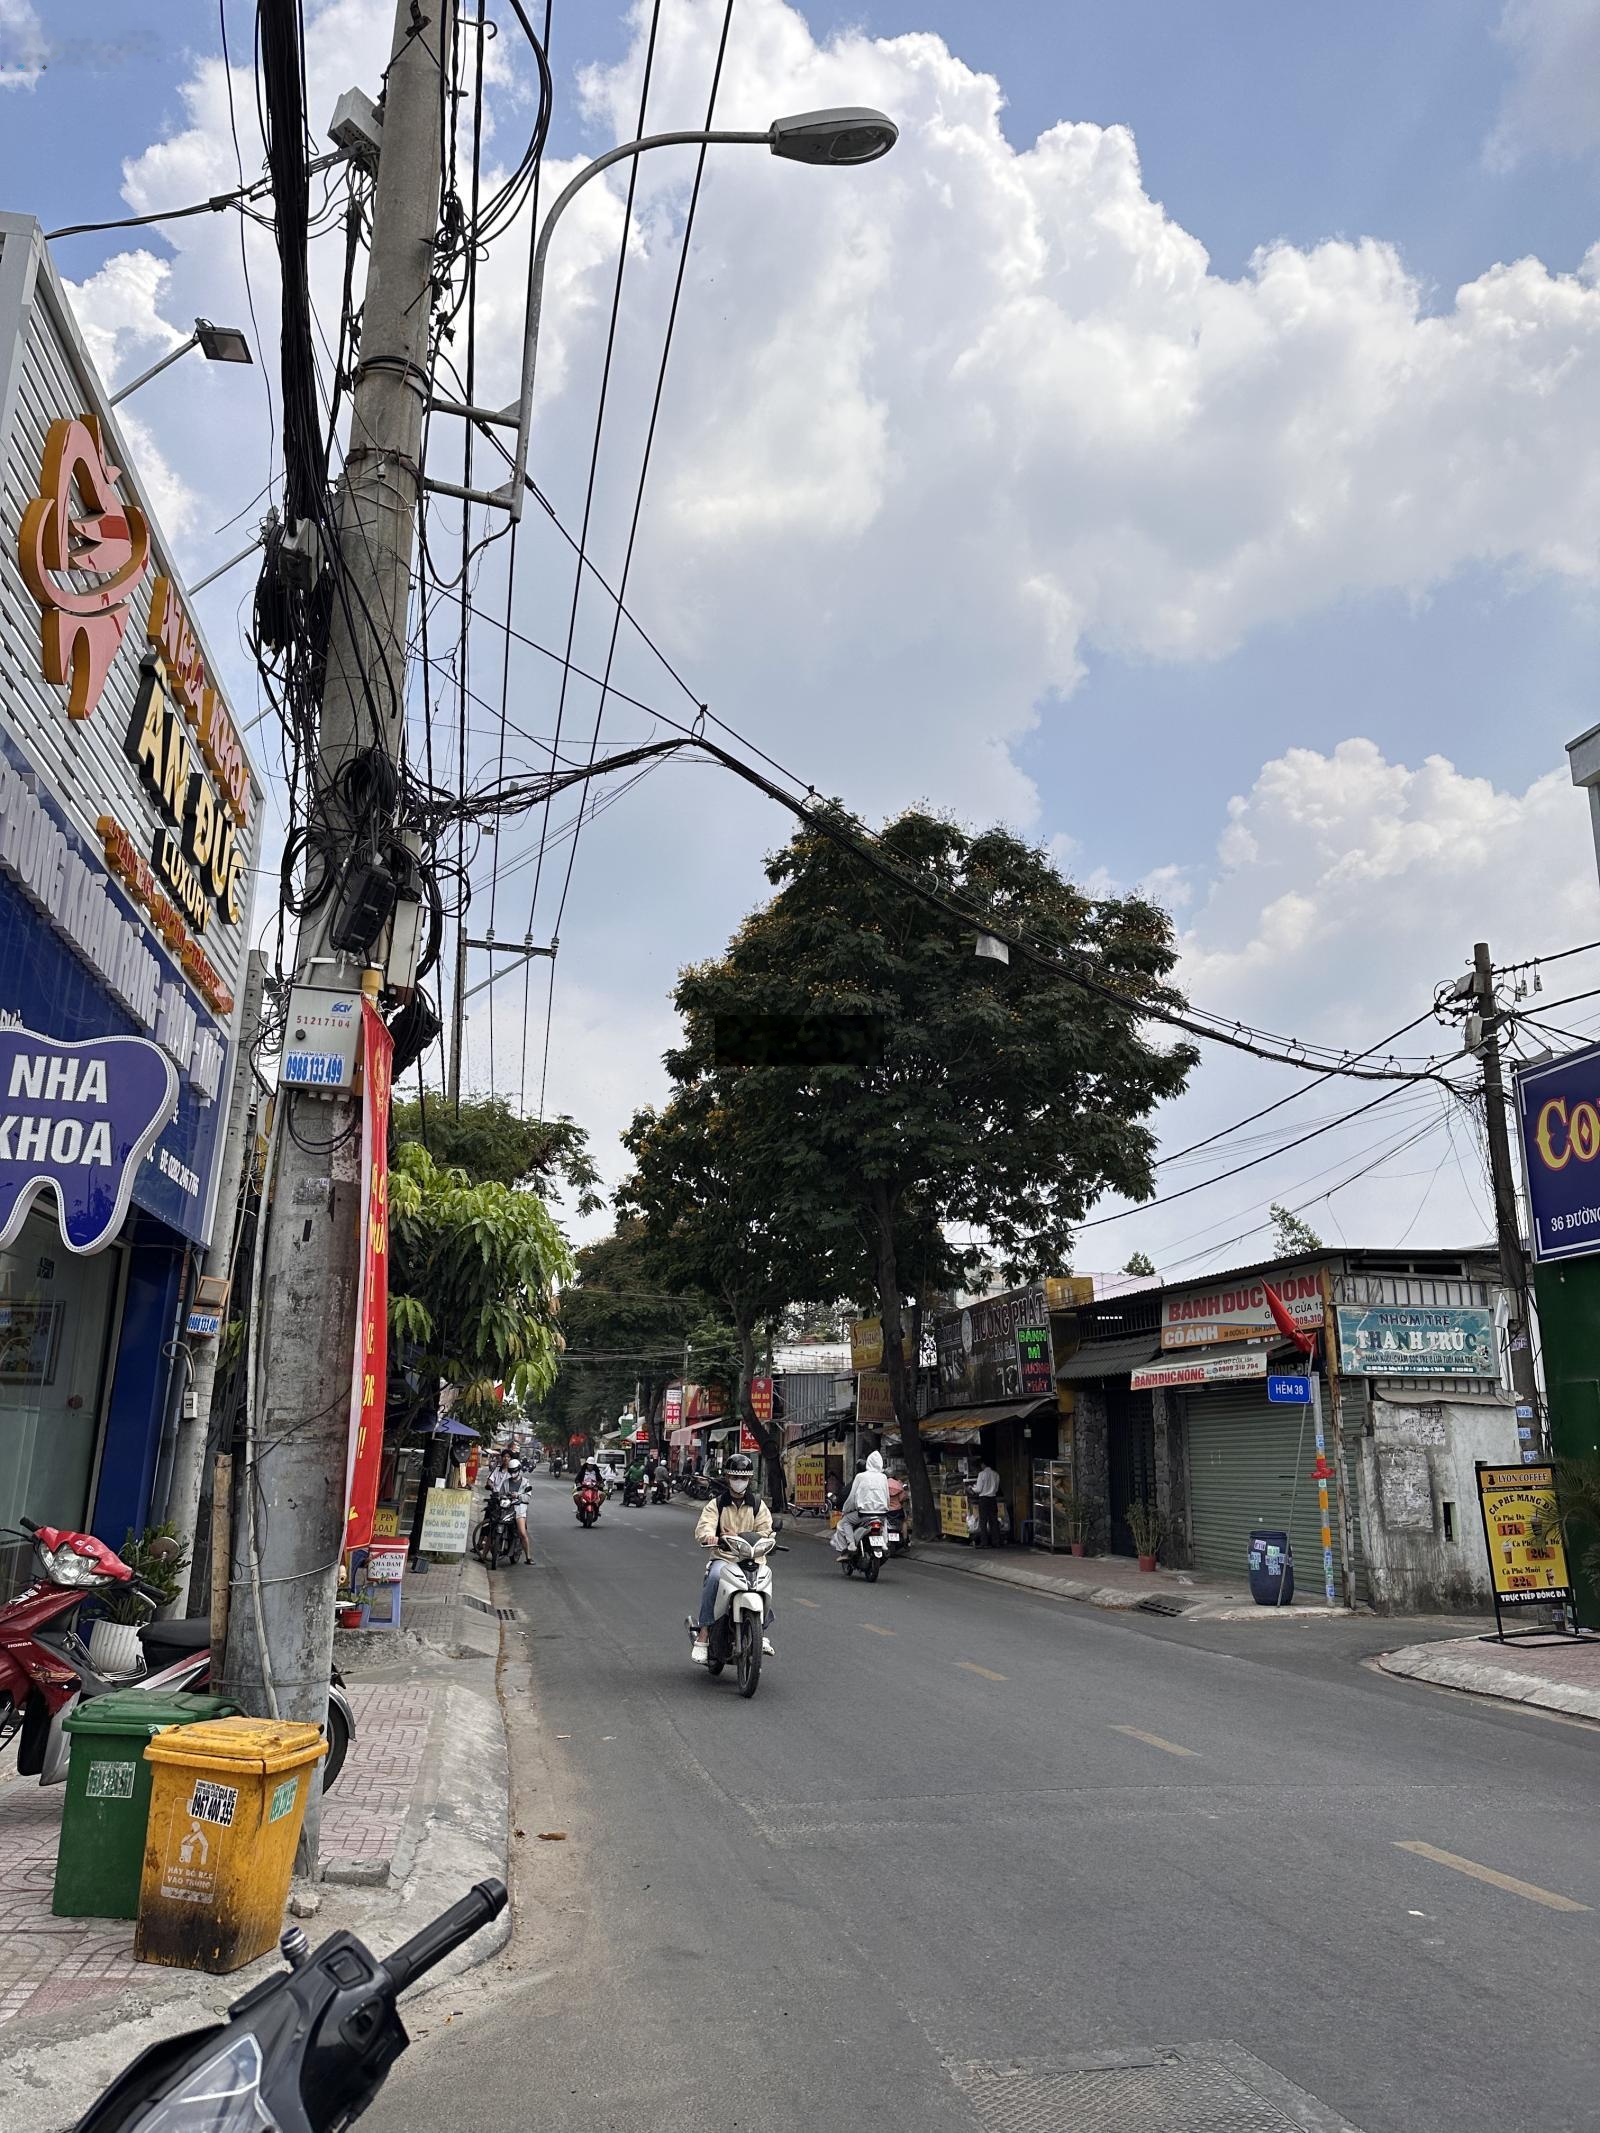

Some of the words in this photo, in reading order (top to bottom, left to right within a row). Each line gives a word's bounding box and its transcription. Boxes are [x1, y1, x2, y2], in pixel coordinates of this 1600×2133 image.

[160, 828, 212, 936] LUXURY
[297, 1016, 351, 1028] 51217104
[286, 1056, 343, 1083] 0988.133.499
[8, 1054, 107, 1103] NHA
[0, 1114, 112, 1166] KHOA
[1551, 1217, 1564, 1232] 36
[1169, 1294, 1221, 1322] BÁNH
[1222, 1285, 1264, 1313] ĐÚC
[1295, 1301, 1313, 1313] CỬA
[1018, 1328, 1047, 1342] BÁNH
[1165, 1327, 1185, 1345] CÔ
[1186, 1323, 1218, 1343] ÁNH
[1356, 1330, 1423, 1350] THANH
[1427, 1327, 1477, 1351] TRÚC
[1275, 1381, 1293, 1395] HẺM
[1294, 1384, 1304, 1395] 38
[1498, 1475, 1517, 1483] LYON
[1519, 1473, 1547, 1481] COFFEE
[1517, 1493, 1541, 1505] MANG
[1501, 1524, 1521, 1536] 17k
[1512, 1576, 1532, 1587] 22k
